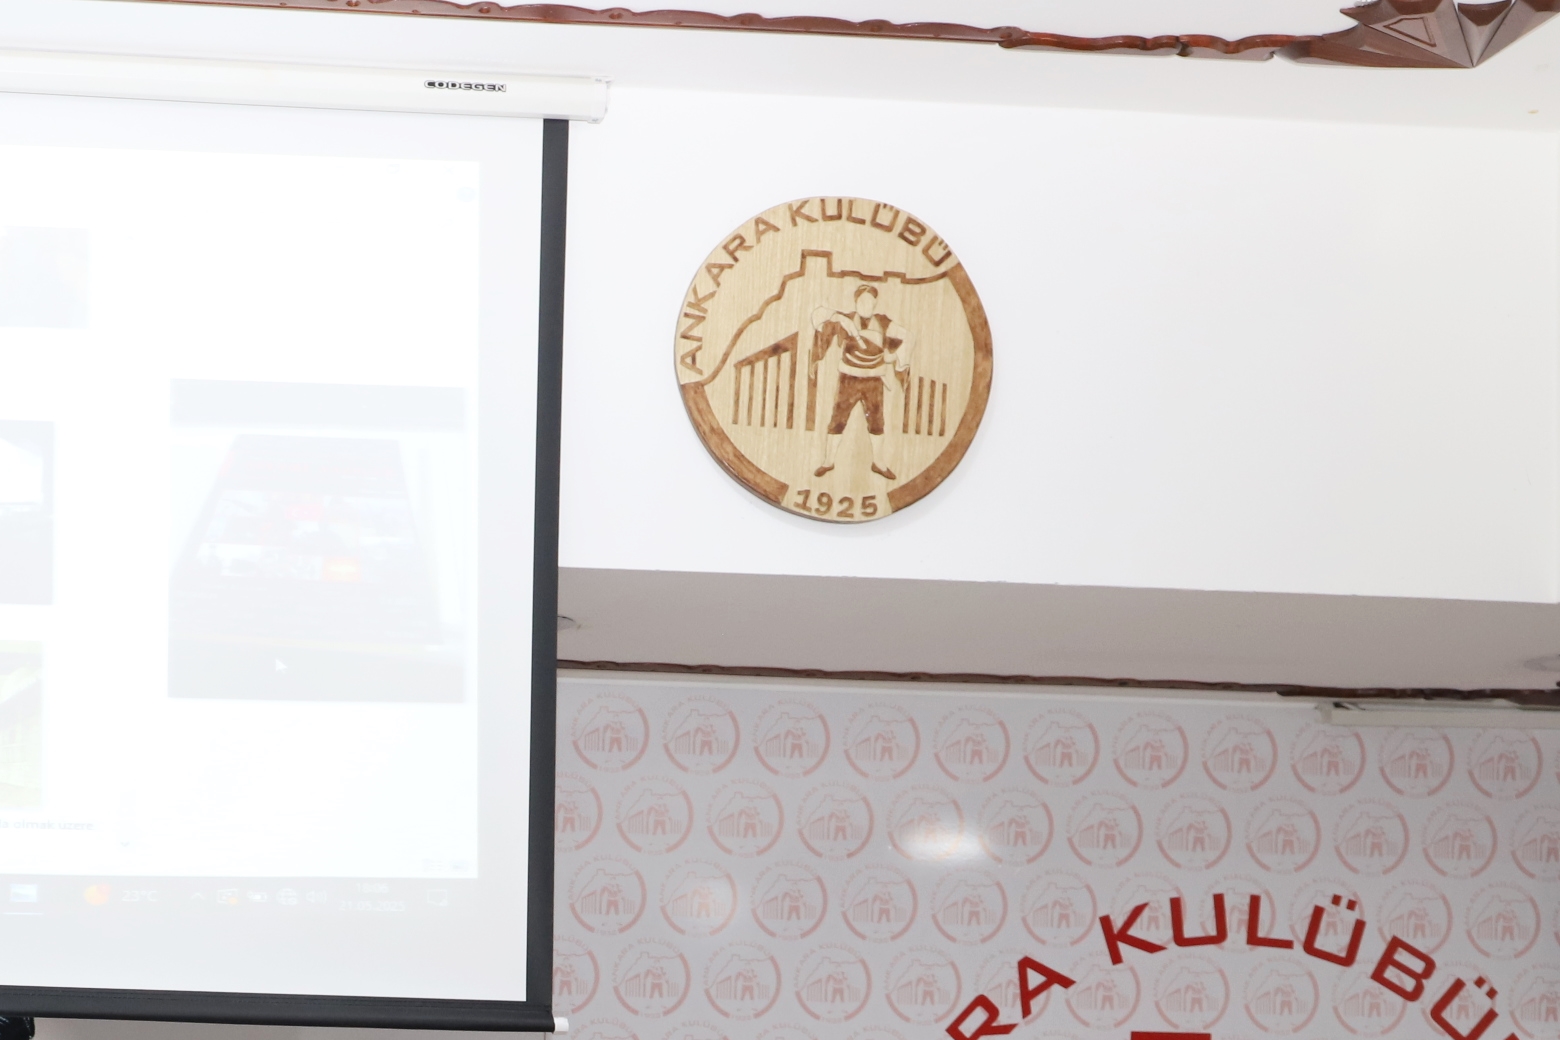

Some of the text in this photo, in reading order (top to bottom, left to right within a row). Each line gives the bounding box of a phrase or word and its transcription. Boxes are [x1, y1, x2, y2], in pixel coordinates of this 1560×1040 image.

[424, 80, 507, 92] CODEGEN
[680, 198, 952, 376] ANKARA KULÜBÜ
[793, 488, 879, 519] 1925
